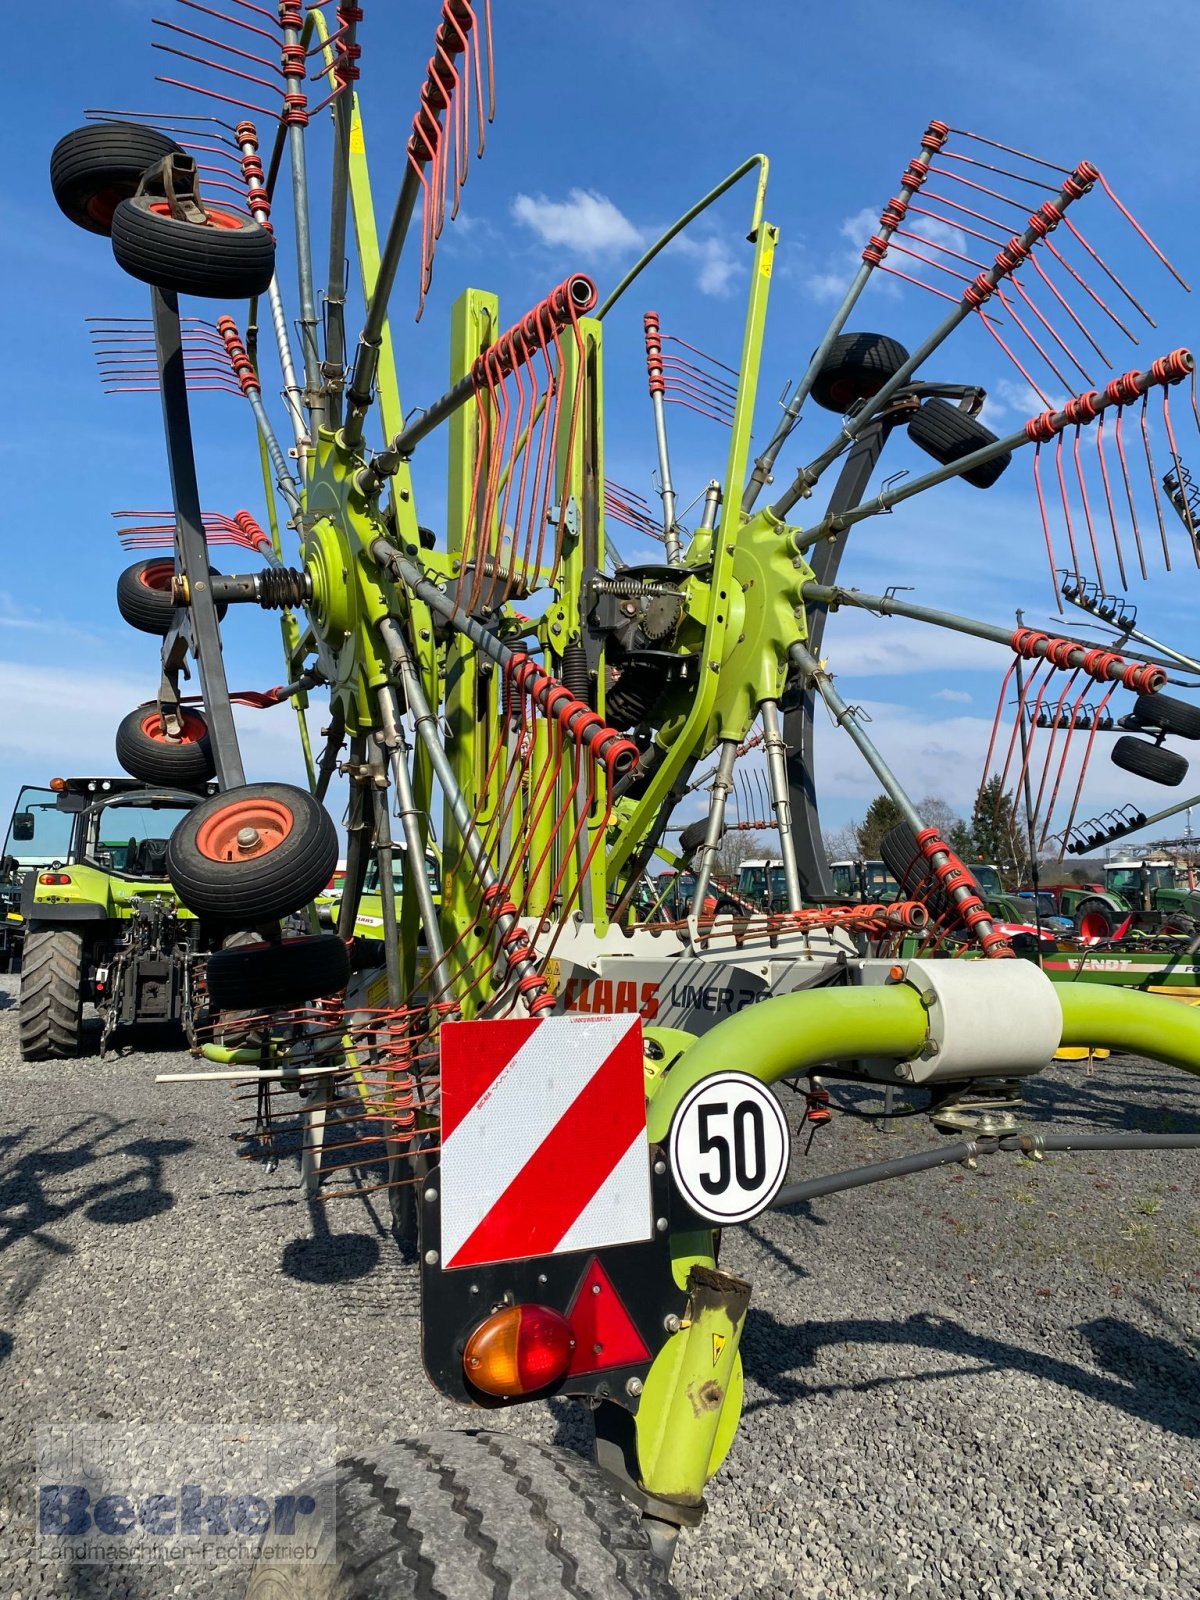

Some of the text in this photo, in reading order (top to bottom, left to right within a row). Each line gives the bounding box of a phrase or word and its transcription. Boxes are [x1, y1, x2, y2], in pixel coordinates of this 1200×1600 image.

[1067, 958, 1132, 971] FENDT
[564, 978, 660, 1019] CLAAS
[671, 984, 733, 1013] LINER
[698, 1100, 766, 1195] 50
